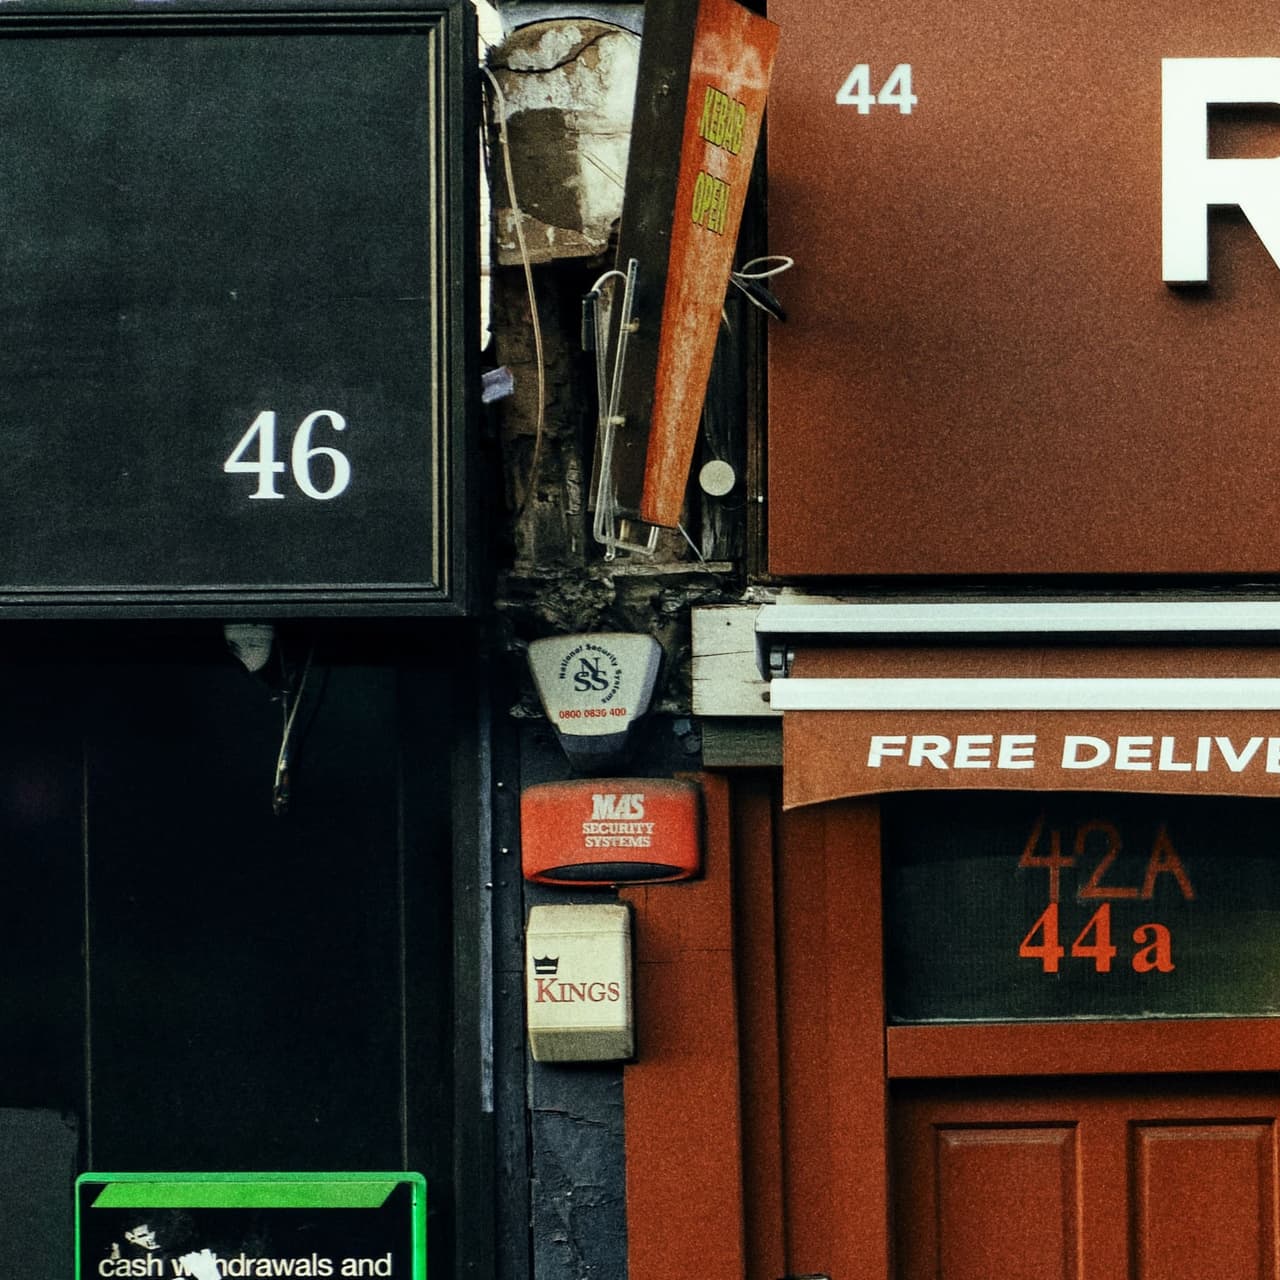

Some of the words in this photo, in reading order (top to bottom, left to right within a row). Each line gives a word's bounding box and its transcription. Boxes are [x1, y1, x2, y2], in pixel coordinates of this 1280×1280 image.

[835, 63, 918, 116] 44
[699, 84, 746, 156] KEBAB
[692, 169, 731, 236] OPEN
[223, 409, 351, 501] 46
[585, 643, 618, 667] Security
[559, 710, 581, 719] 0800
[610, 707, 627, 717] 400
[866, 734, 1037, 769] FREE
[592, 794, 645, 820] MAS
[582, 822, 655, 835] SECURITY
[585, 836, 651, 848] SYSTEMS
[1018, 812, 1197, 901] 42A
[1018, 902, 1176, 973] 44a
[99, 1253, 164, 1278] cash
[172, 1252, 333, 1278] whdrawals
[341, 1252, 392, 1278] and
